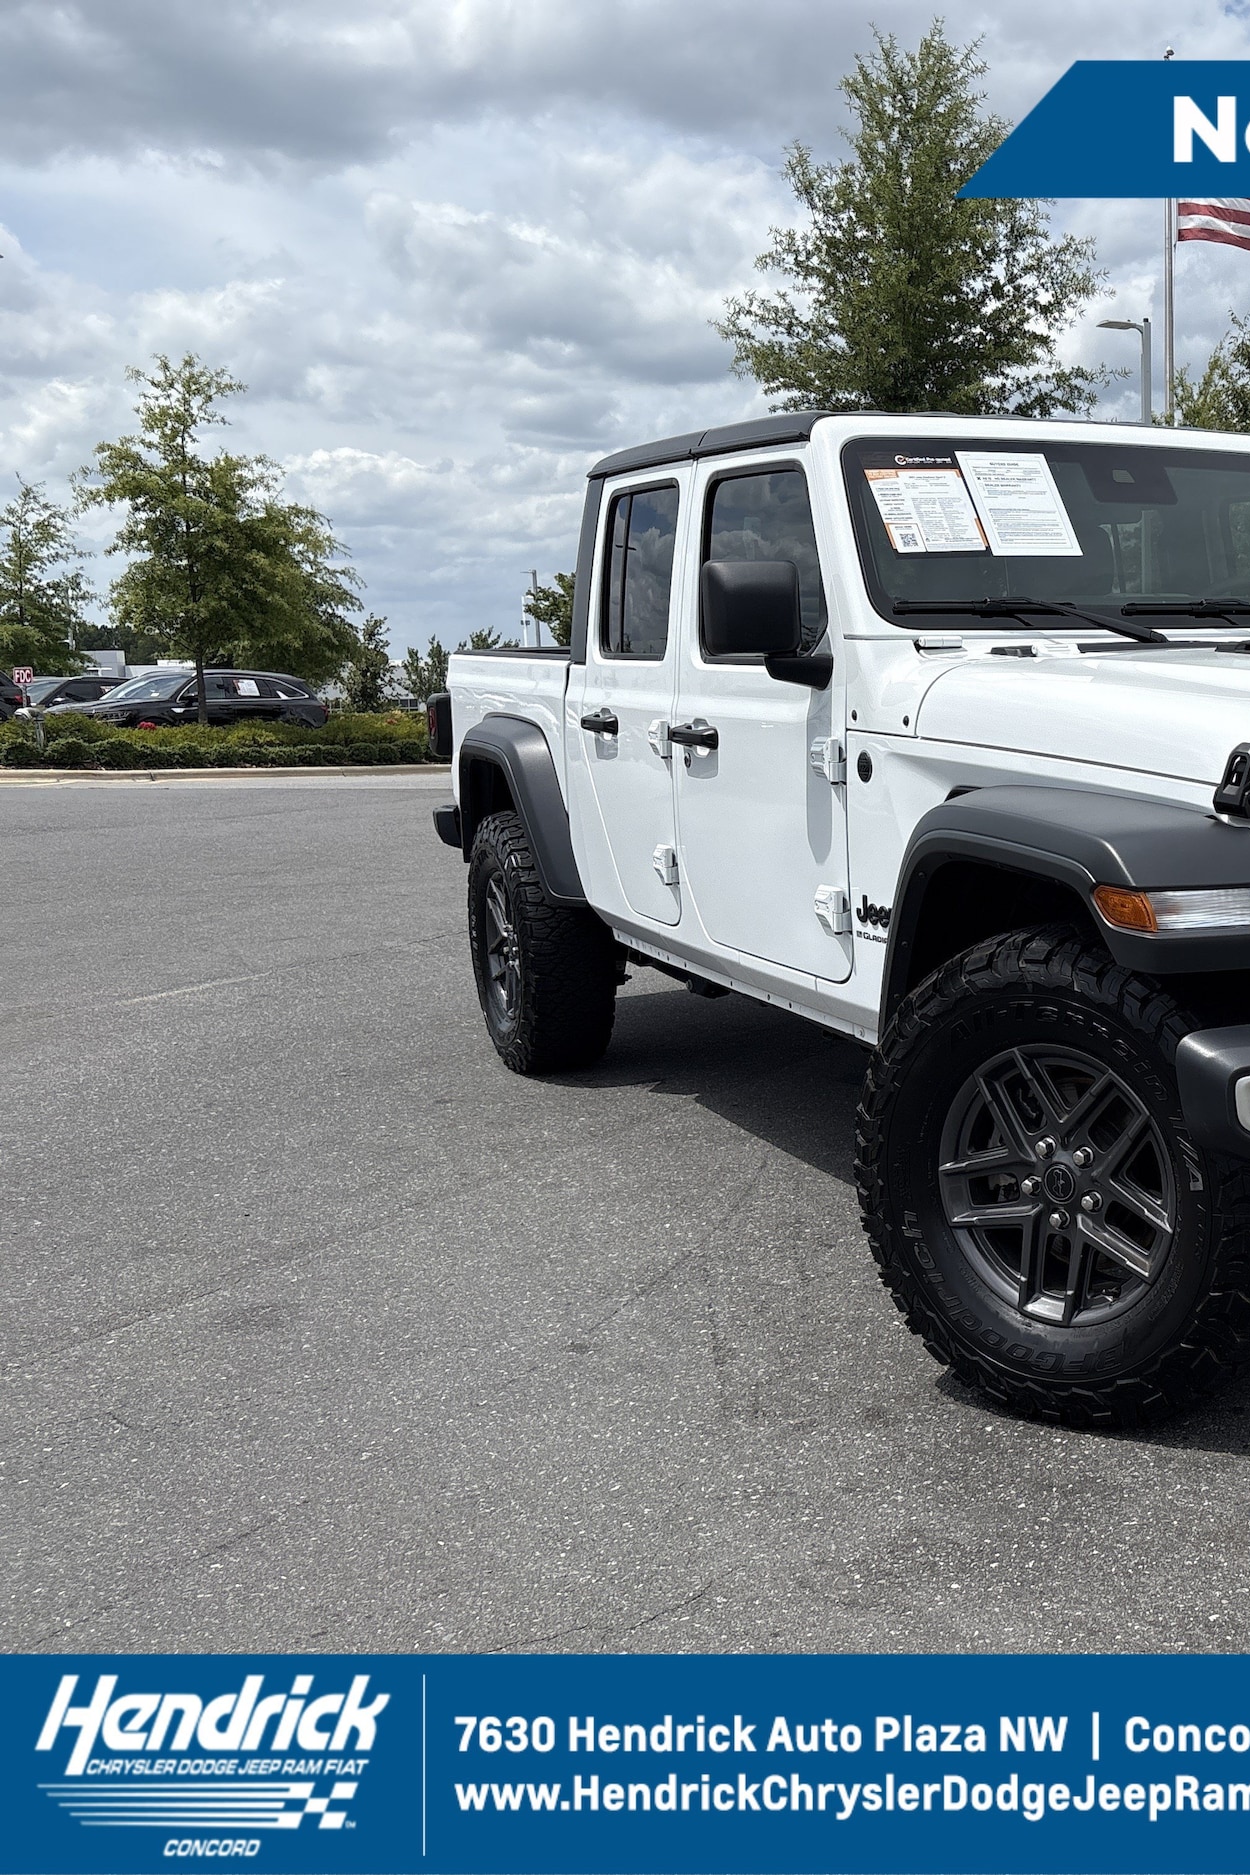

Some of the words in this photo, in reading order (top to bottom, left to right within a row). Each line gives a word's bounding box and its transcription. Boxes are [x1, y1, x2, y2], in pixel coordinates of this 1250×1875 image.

[15, 669, 31, 683] FDC
[856, 894, 892, 928] Jee
[950, 999, 1168, 1102] All-Terrain
[900, 1210, 1125, 1374] BFGoodrich
